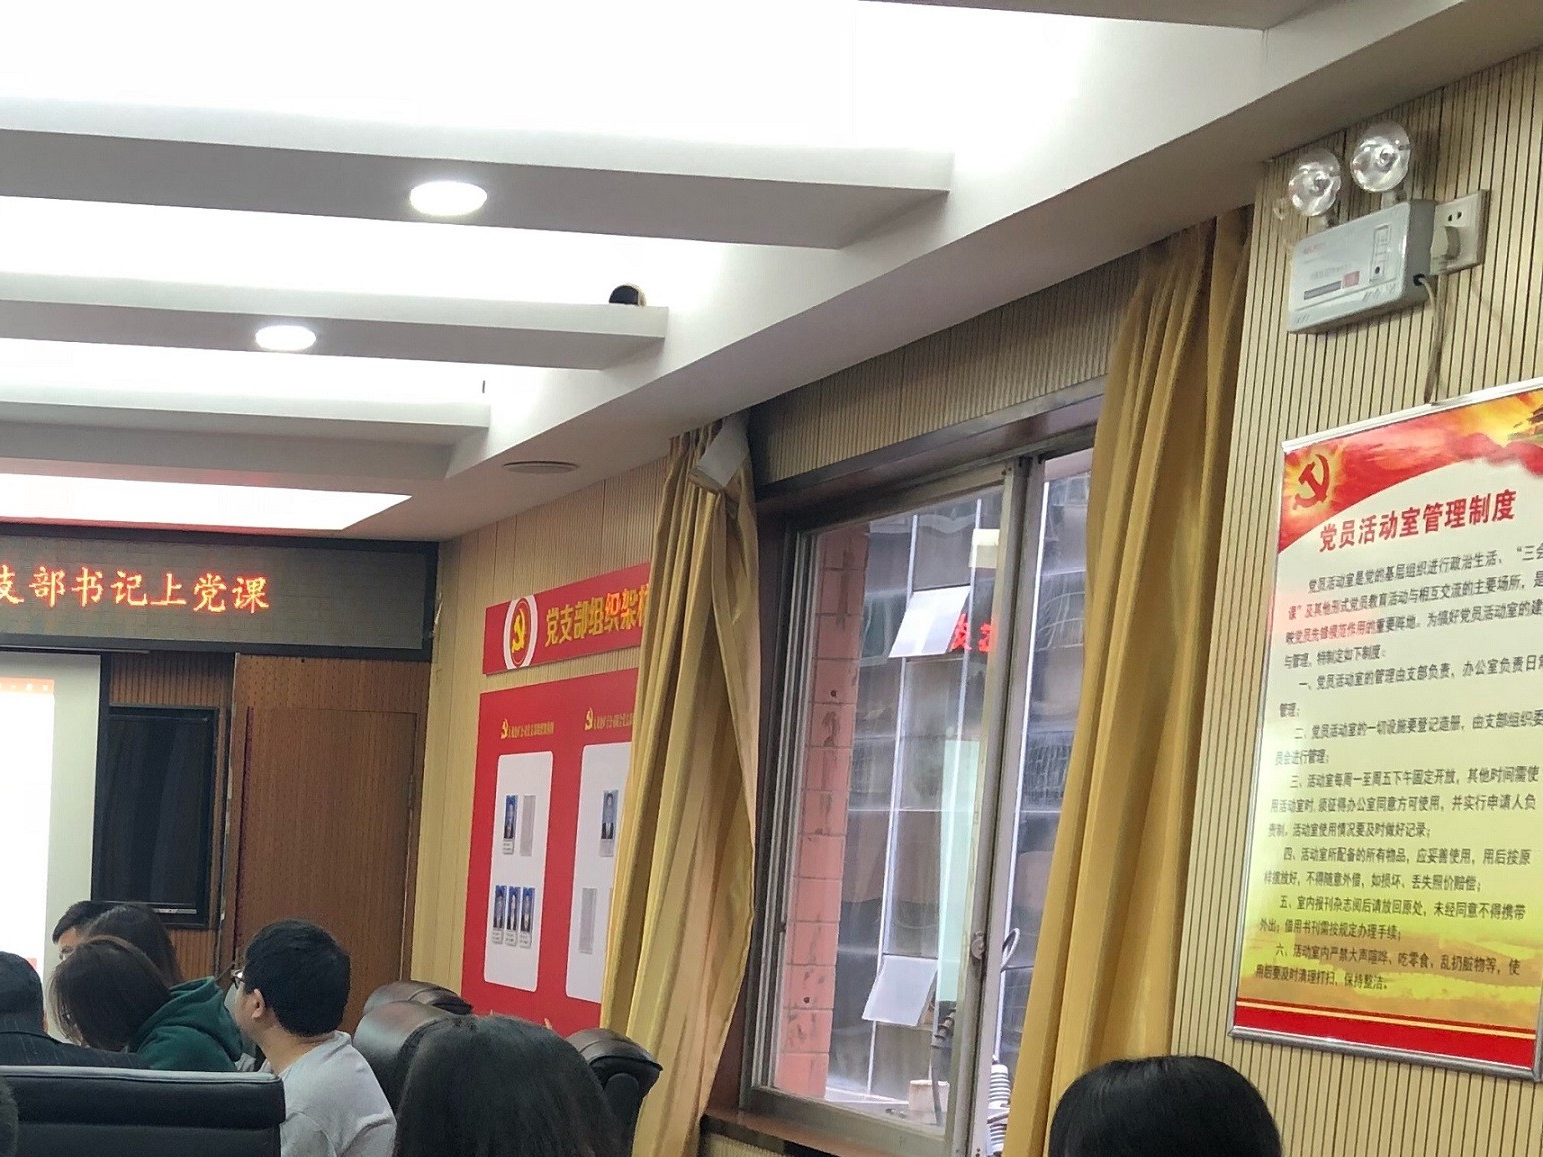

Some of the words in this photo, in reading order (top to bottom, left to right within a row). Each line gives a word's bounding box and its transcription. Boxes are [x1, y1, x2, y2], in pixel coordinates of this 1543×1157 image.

[1319, 488, 1517, 553] 党员活动室管理制度
